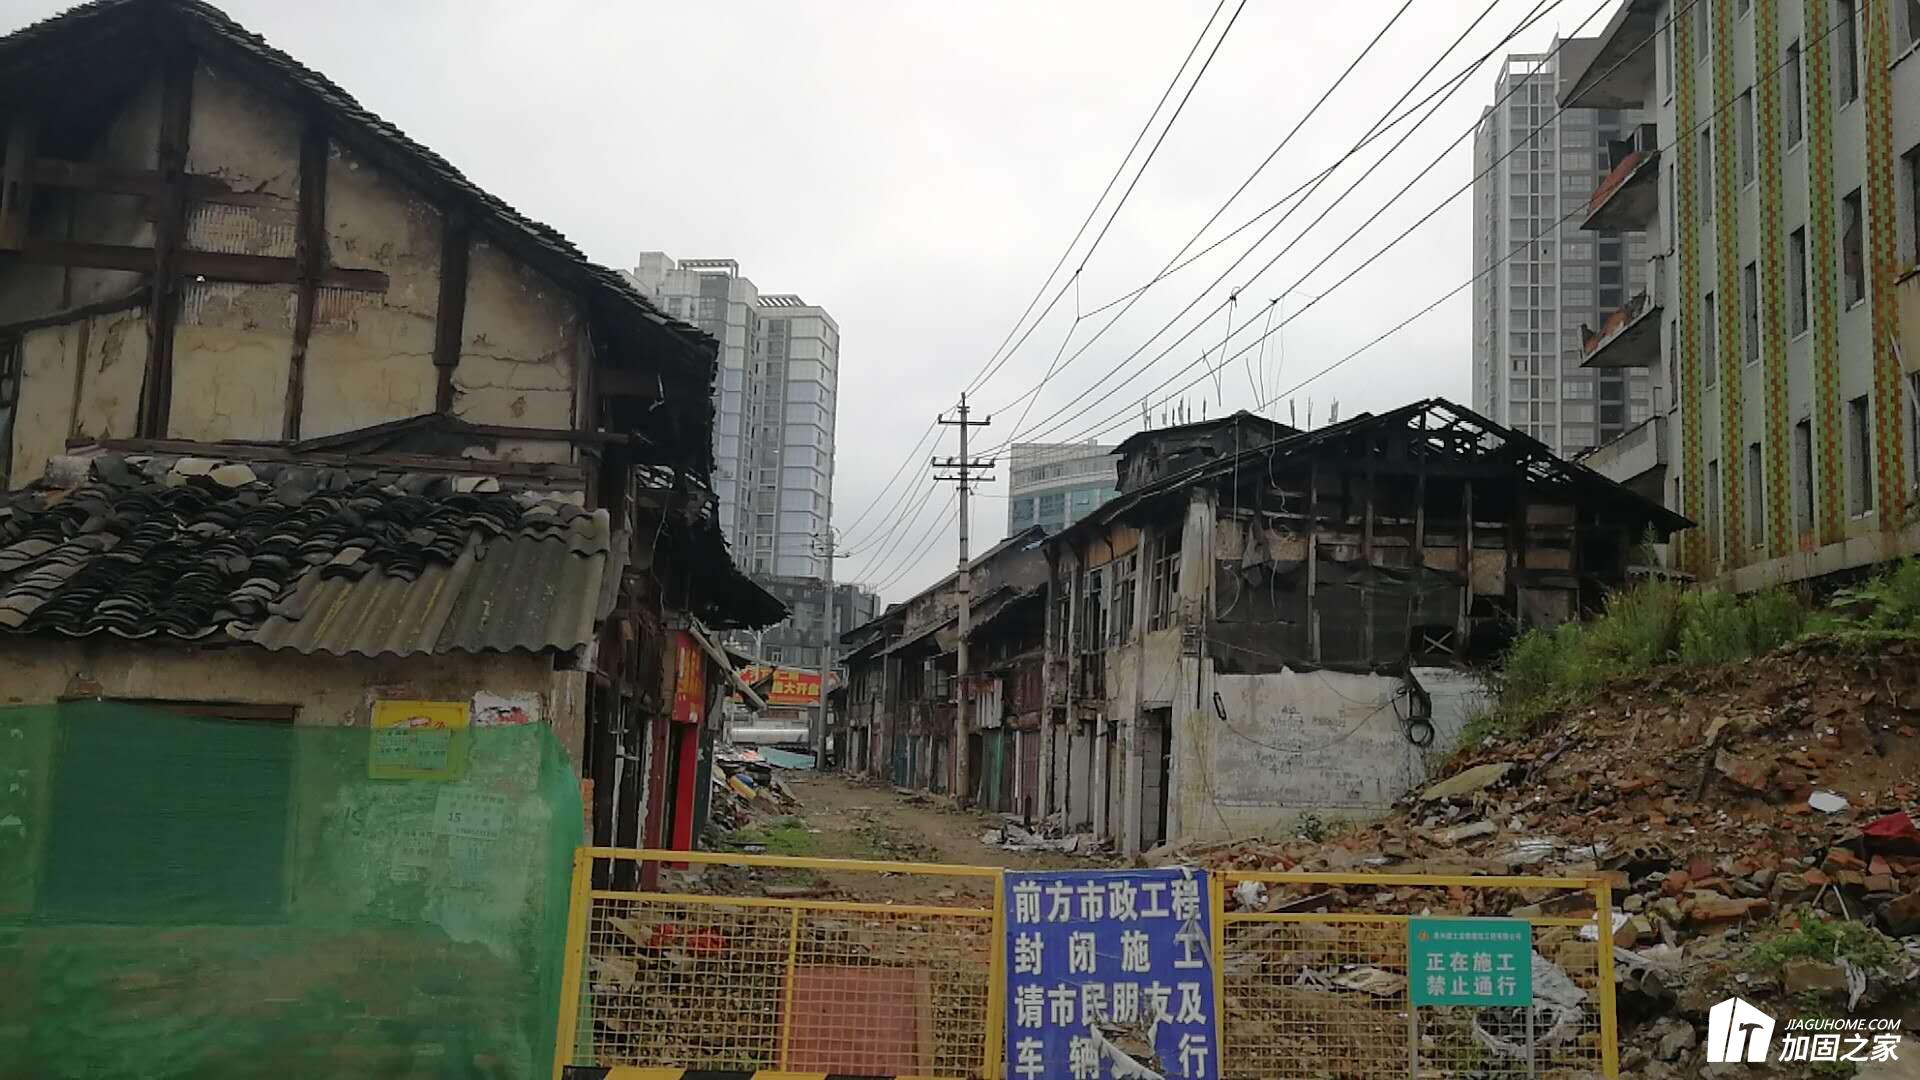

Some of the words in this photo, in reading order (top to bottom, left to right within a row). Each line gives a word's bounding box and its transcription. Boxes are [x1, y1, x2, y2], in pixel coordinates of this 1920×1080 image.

[1013, 880, 1201, 923] 前方市政工程
[1014, 930, 1204, 974] 封闭施工
[1425, 952, 1515, 972] 正在施工
[1014, 981, 1206, 1028] 请市民朋友及
[1426, 975, 1516, 996] 禁止通行
[1015, 1033, 1208, 1080] 车辆行
